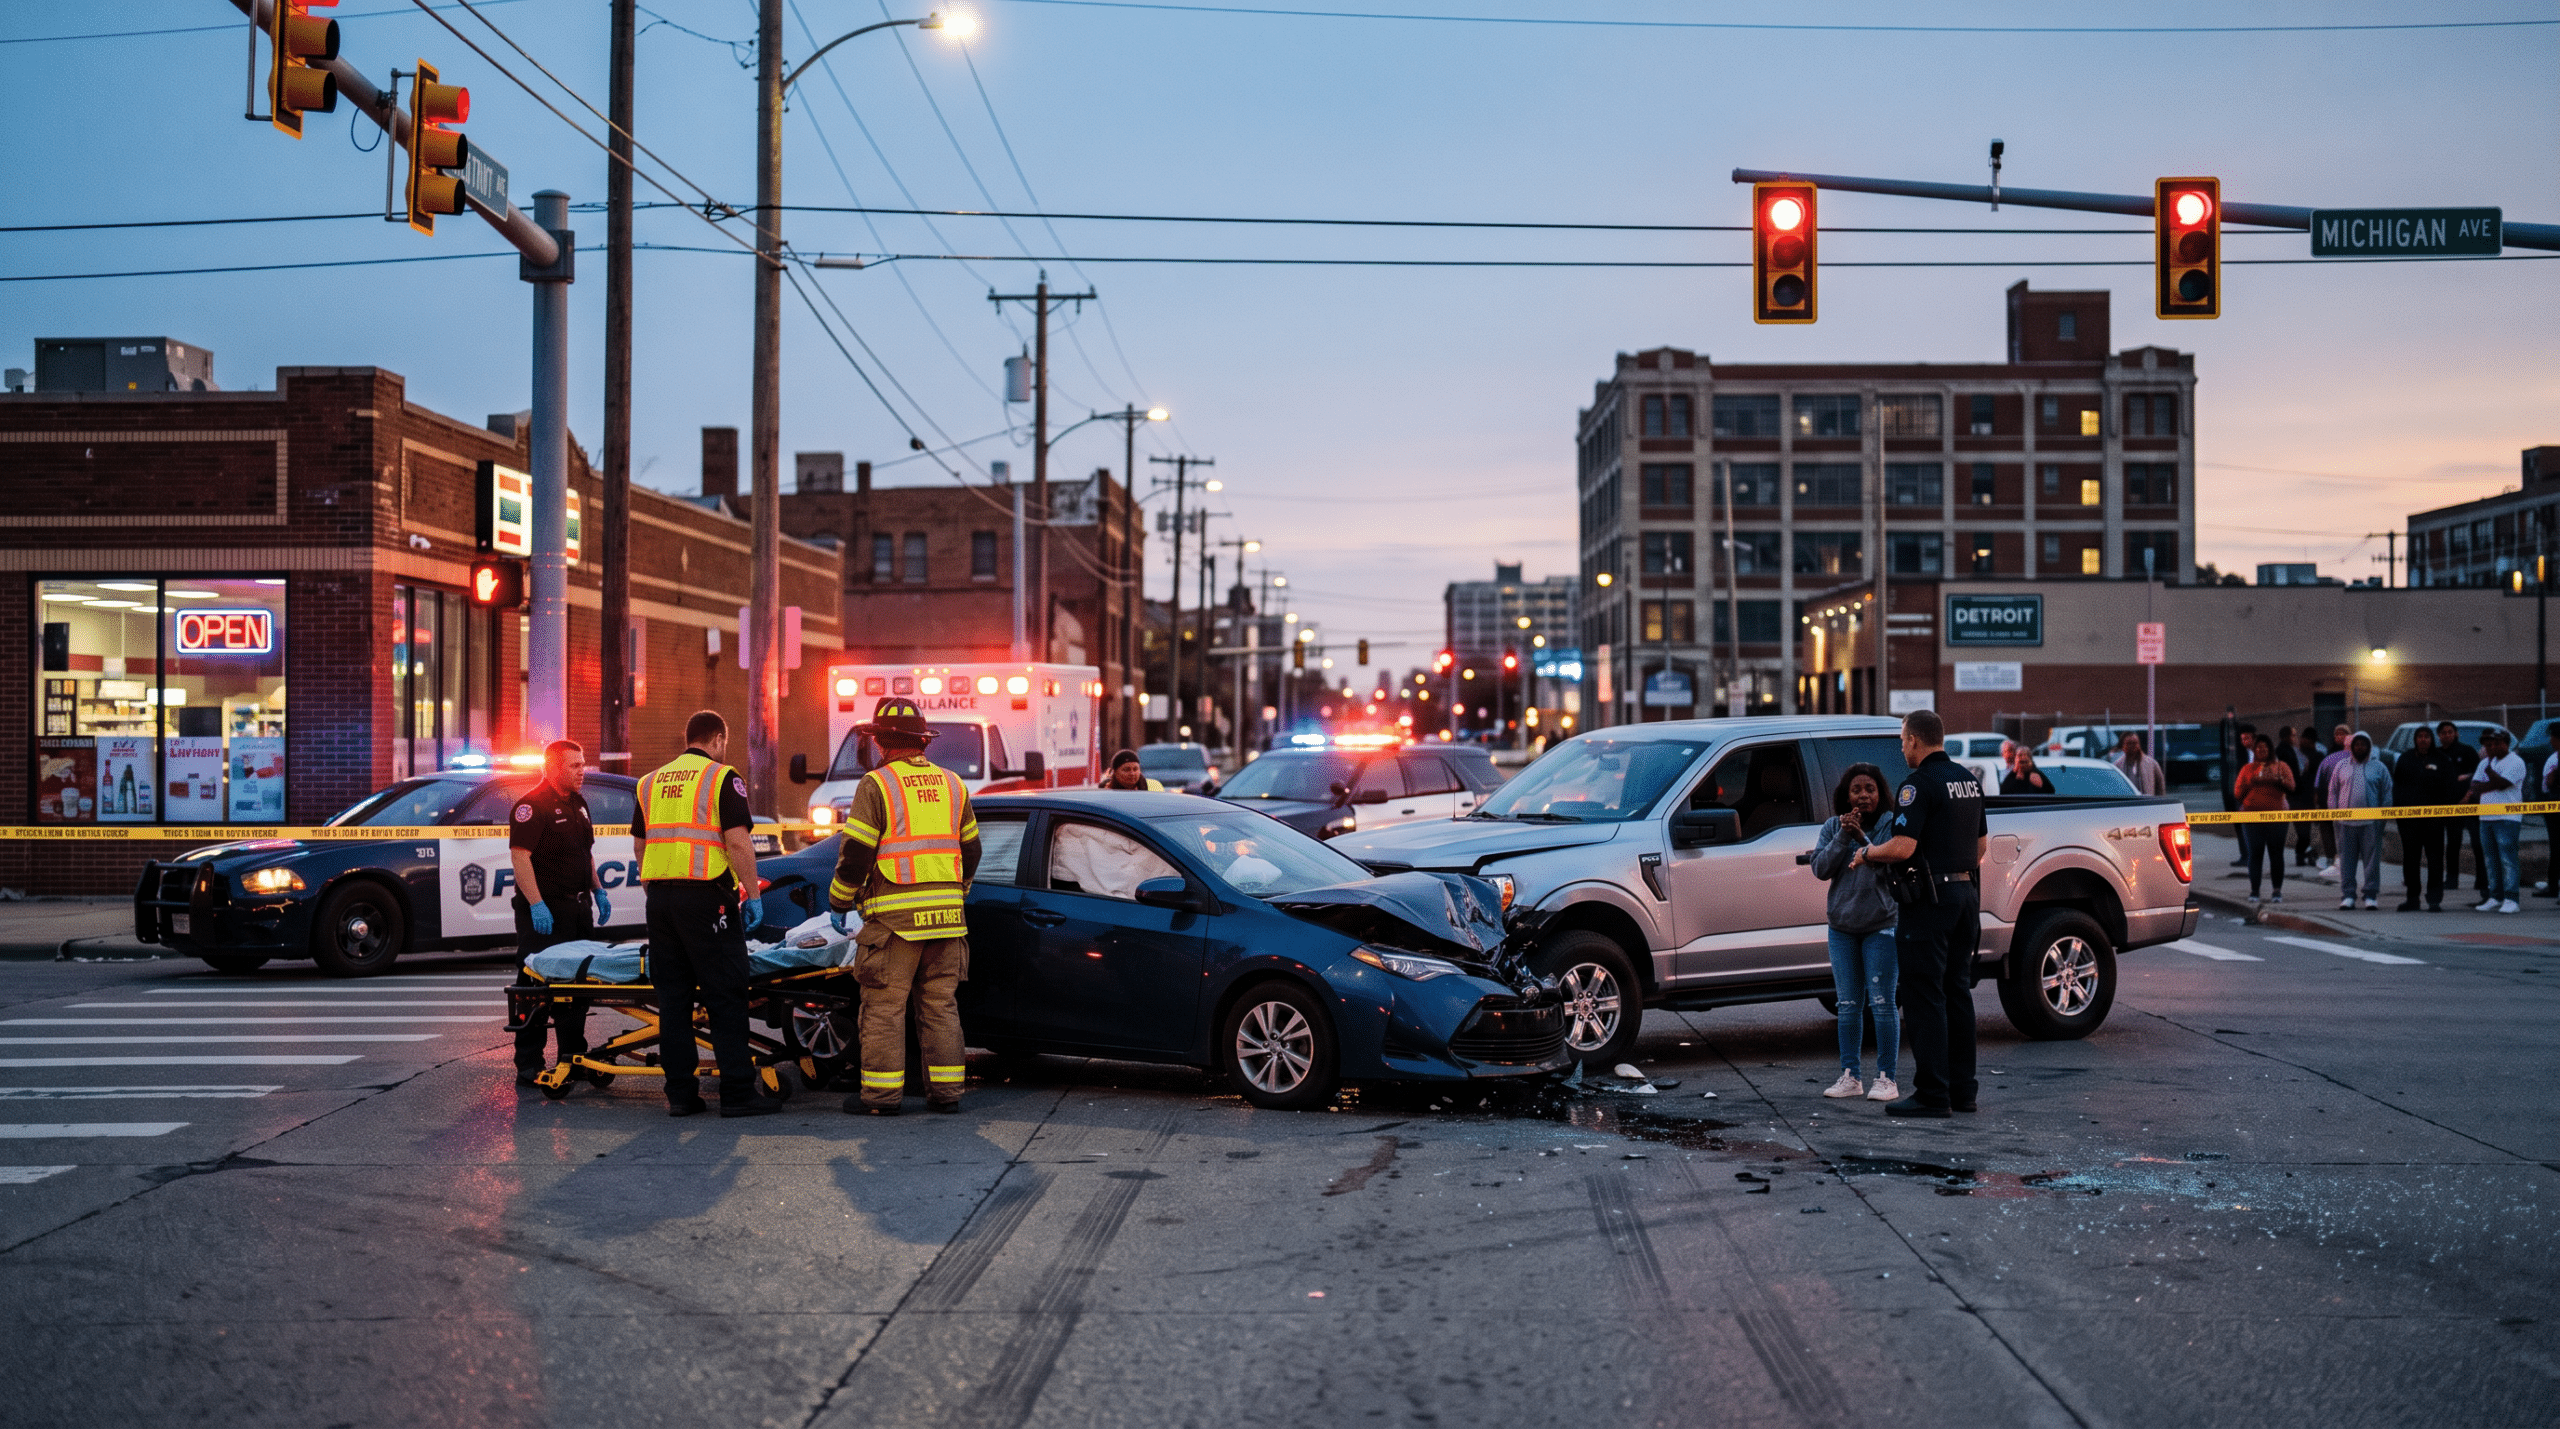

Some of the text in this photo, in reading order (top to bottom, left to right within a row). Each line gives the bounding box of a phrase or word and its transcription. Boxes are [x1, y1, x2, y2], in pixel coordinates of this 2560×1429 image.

[2321, 218, 2492, 248] MICHIGAN AVE
[1955, 607, 2034, 624] DETROIT
[181, 615, 267, 649] OPEN
[914, 697, 979, 710] ULANCE
[657, 770, 699, 783] DETROIT
[902, 774, 944, 788] DETROIT
[661, 784, 685, 799] FIRE
[916, 789, 940, 803] FIRE
[1946, 781, 1981, 799] POLICE
